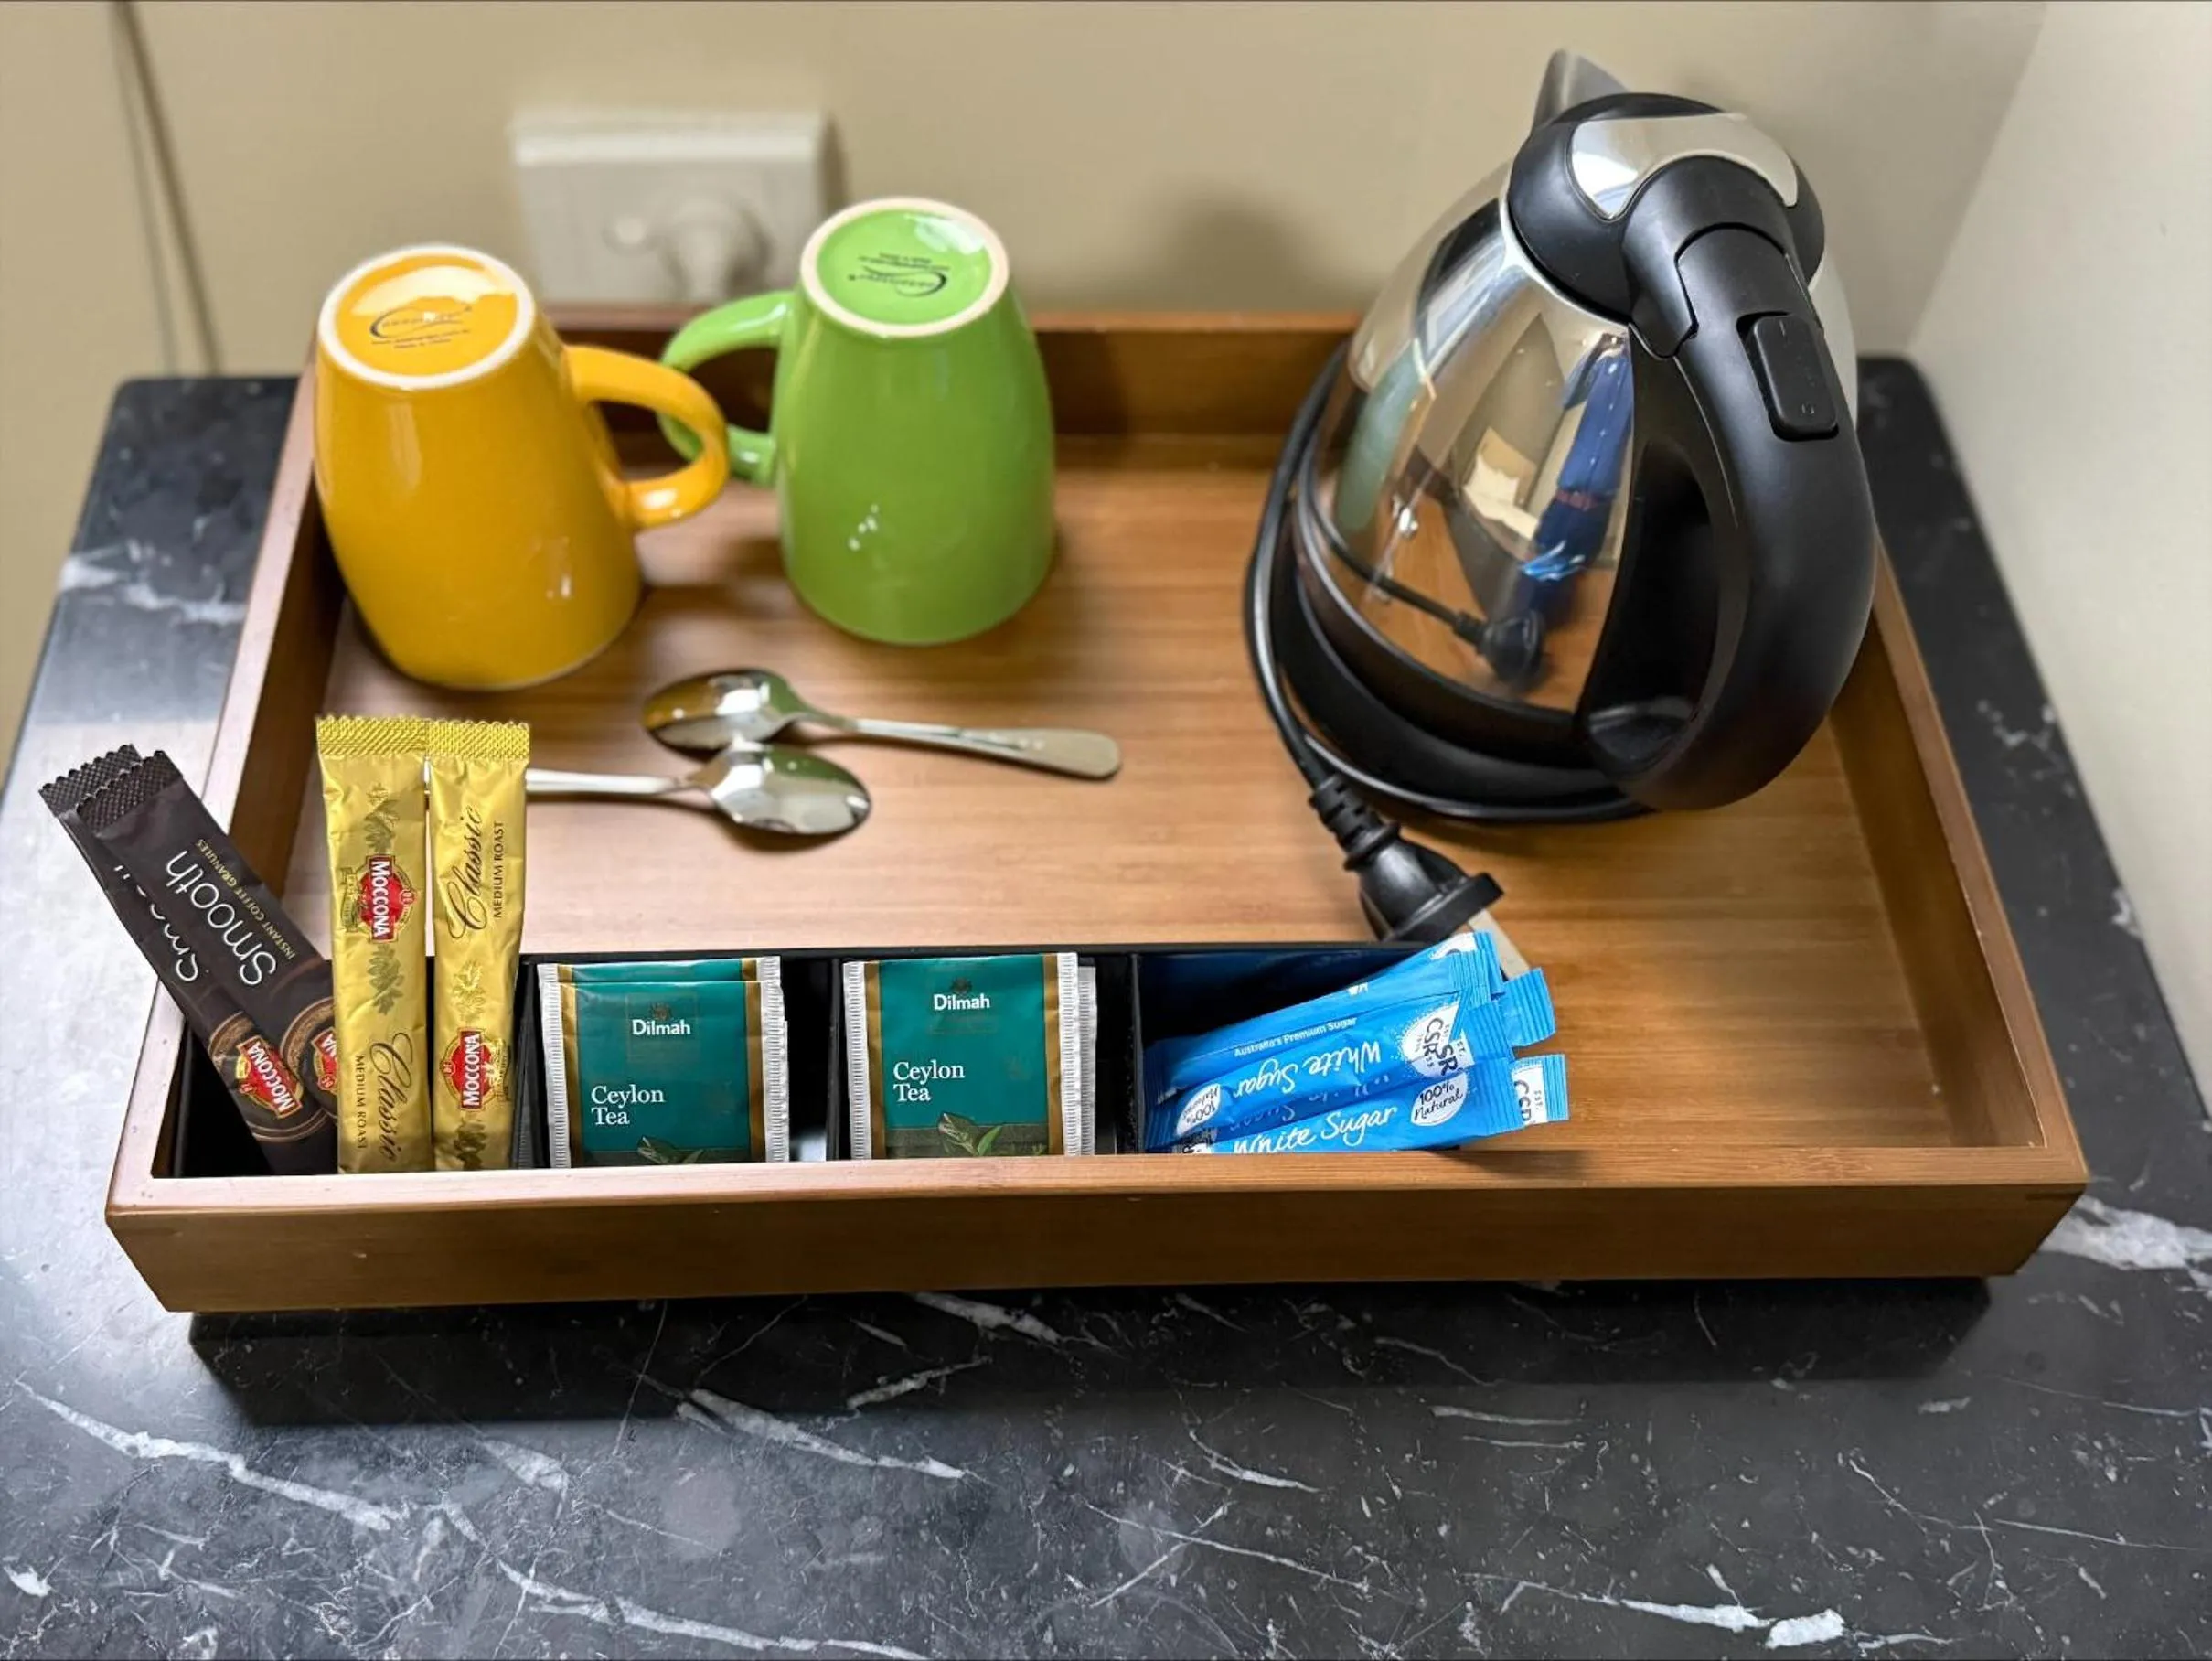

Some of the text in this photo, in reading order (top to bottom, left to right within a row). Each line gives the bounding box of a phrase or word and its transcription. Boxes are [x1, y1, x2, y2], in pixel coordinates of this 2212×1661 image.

[446, 805, 487, 939] Classic
[493, 820, 504, 918] MEDIUM ROAST
[166, 850, 276, 985] Smooth
[371, 860, 390, 938] MOCCONA
[262, 921, 296, 959] INSTANT
[933, 993, 991, 1010] Dilmah
[632, 1019, 691, 1035] Dilmah
[1234, 1017, 1358, 1057] Australia's Premium Sugar
[1422, 1017, 1444, 1057] CSR
[247, 1041, 295, 1112] MOCCONA
[462, 1034, 480, 1107] MOCCONA
[892, 1059, 966, 1085] Ceylon
[1233, 1057, 1298, 1097] Sugar
[1302, 1041, 1382, 1077] White
[355, 1055, 368, 1150] MEDIUM ROAST
[369, 1032, 414, 1163] Classic
[590, 1084, 666, 1108] Ceylon
[892, 1083, 932, 1102] Tea
[1414, 1088, 1464, 1120] Natural
[1419, 1081, 1454, 1105] 100%
[590, 1106, 630, 1125] Tea
[1320, 1106, 1398, 1147] Sugar
